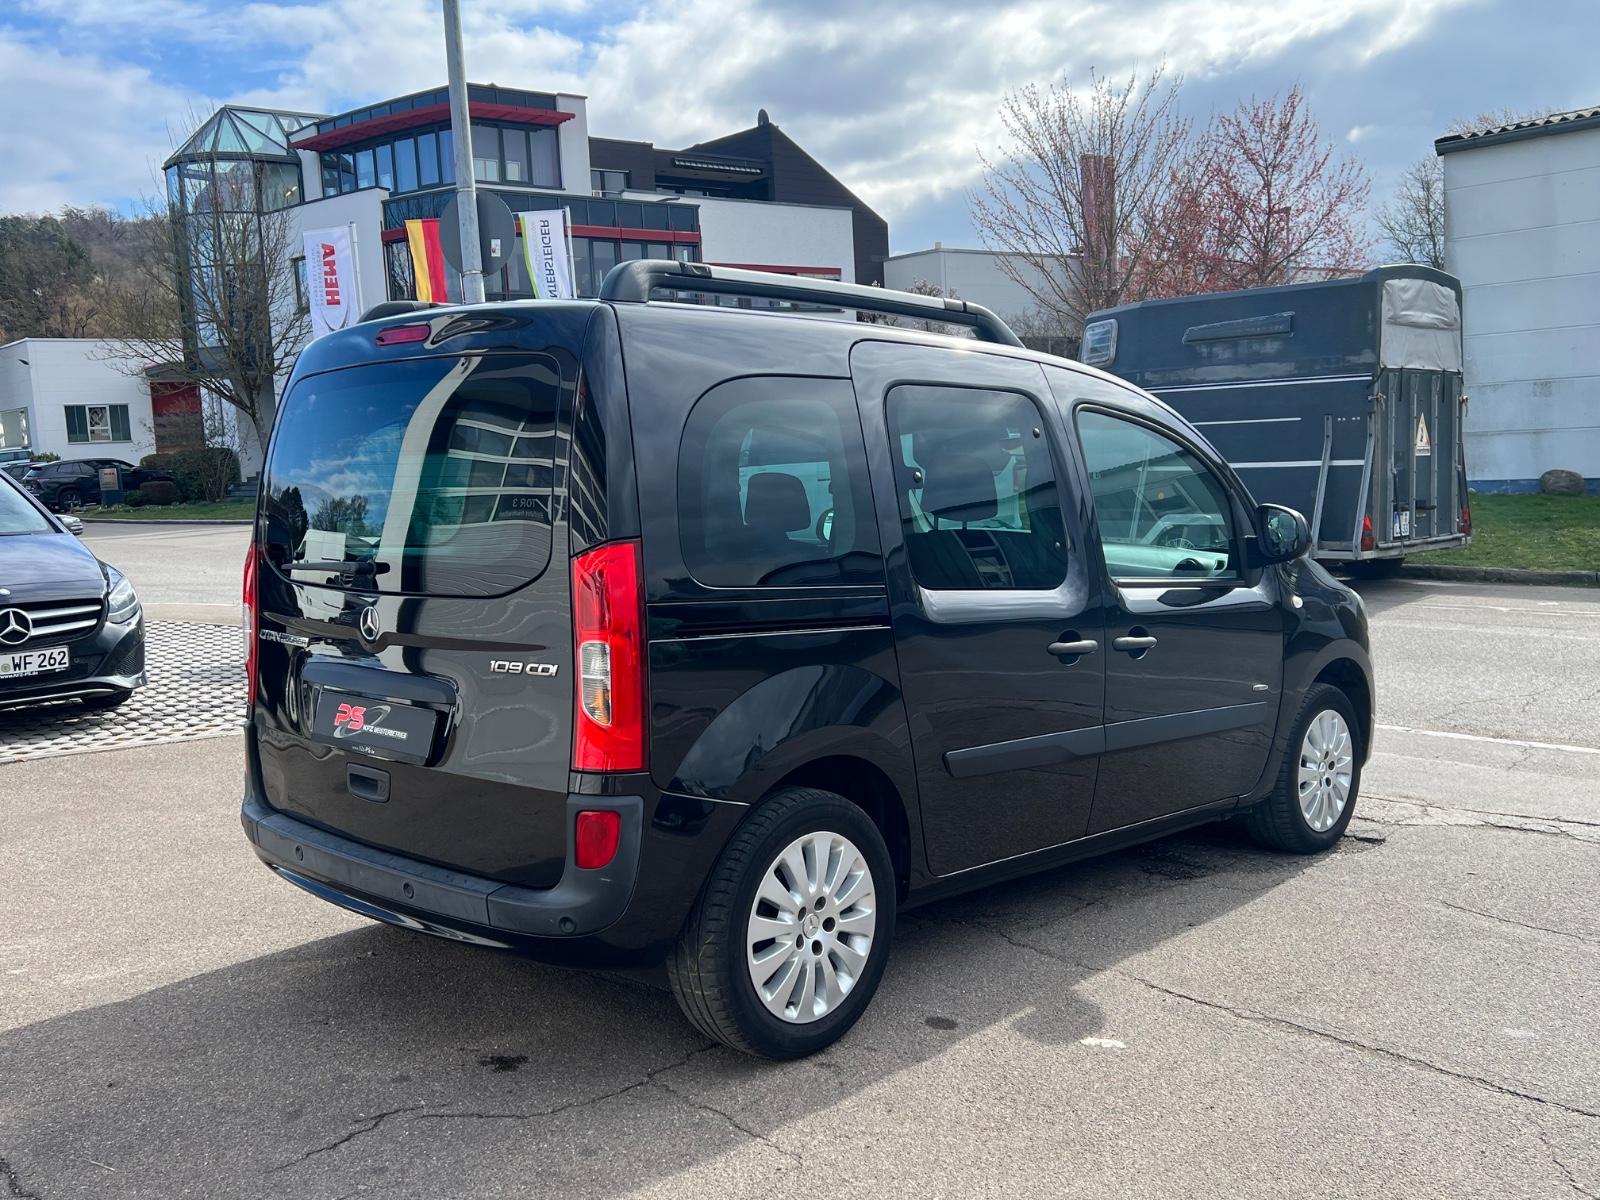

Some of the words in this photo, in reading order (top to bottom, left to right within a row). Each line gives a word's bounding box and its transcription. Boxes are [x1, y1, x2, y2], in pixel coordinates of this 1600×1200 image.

[11, 654, 33, 671] WF
[38, 651, 66, 668] 262
[489, 660, 523, 674] 109
[525, 663, 559, 677] CDI
[334, 703, 367, 731] PS
